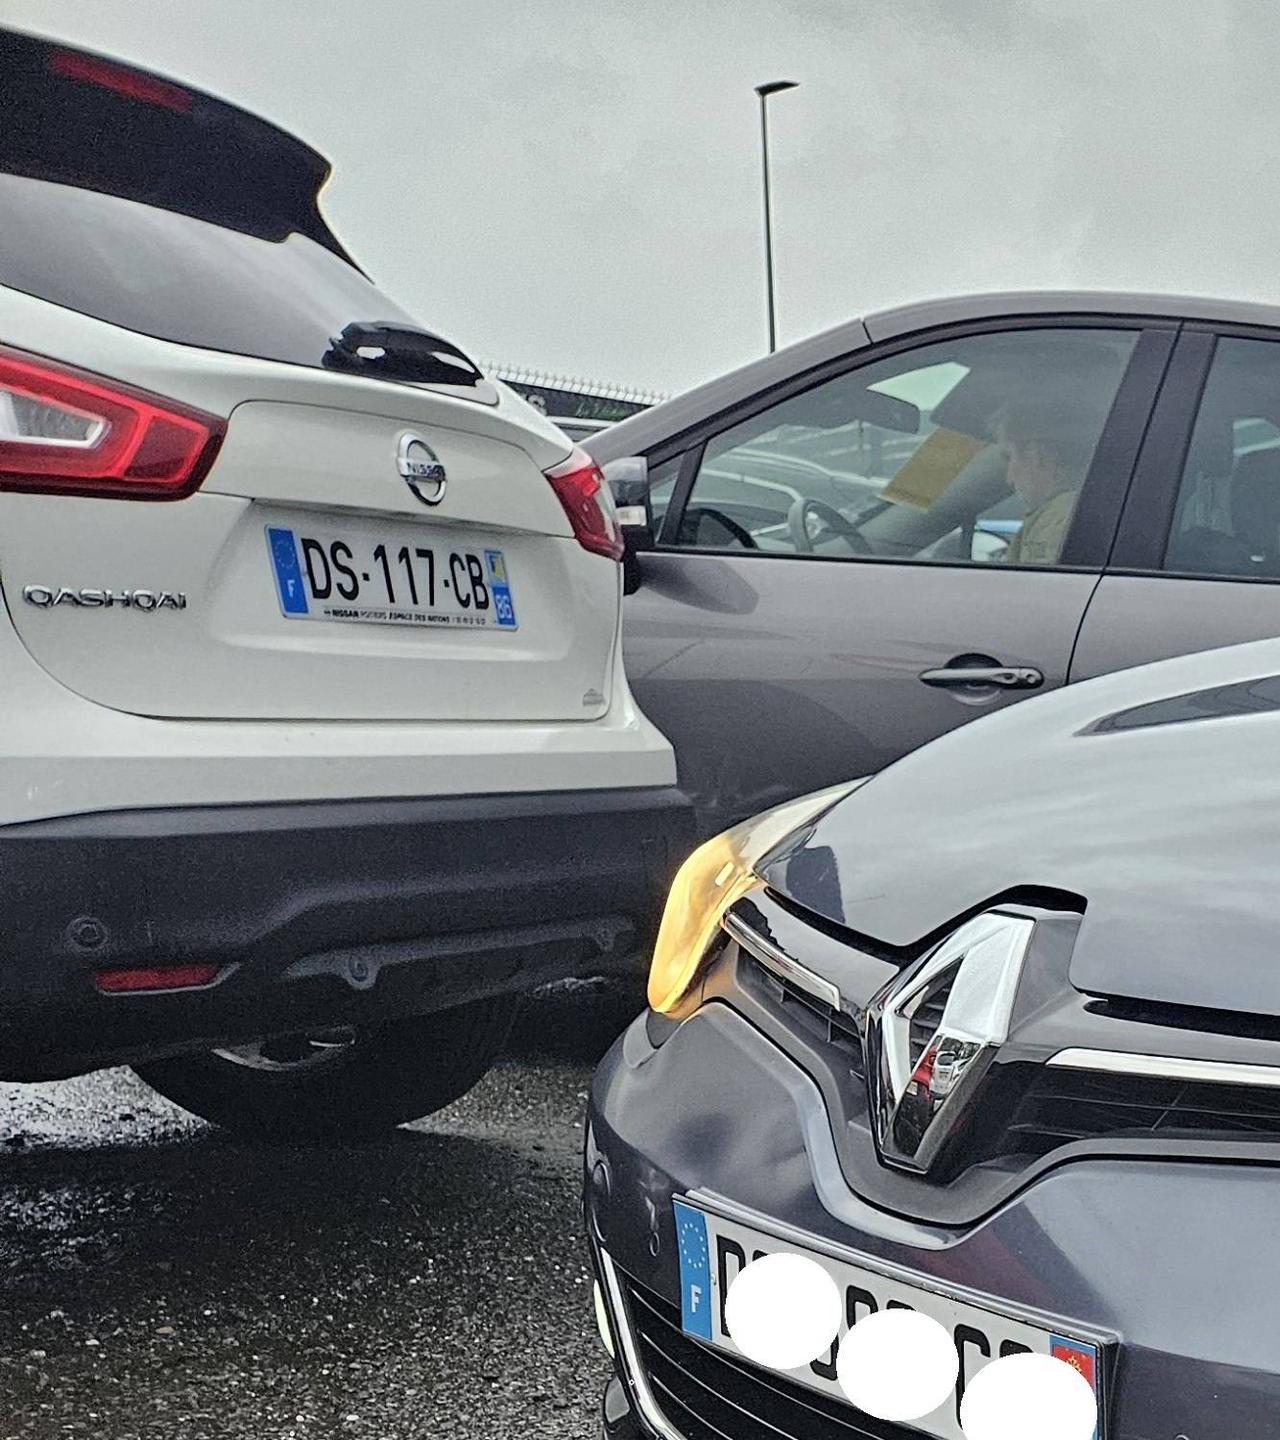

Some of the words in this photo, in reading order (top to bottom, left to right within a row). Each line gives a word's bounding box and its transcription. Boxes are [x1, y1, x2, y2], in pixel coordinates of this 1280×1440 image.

[23, 584, 187, 612] QASHQAI
[287, 579, 295, 598] F
[691, 1284, 702, 1313] F
